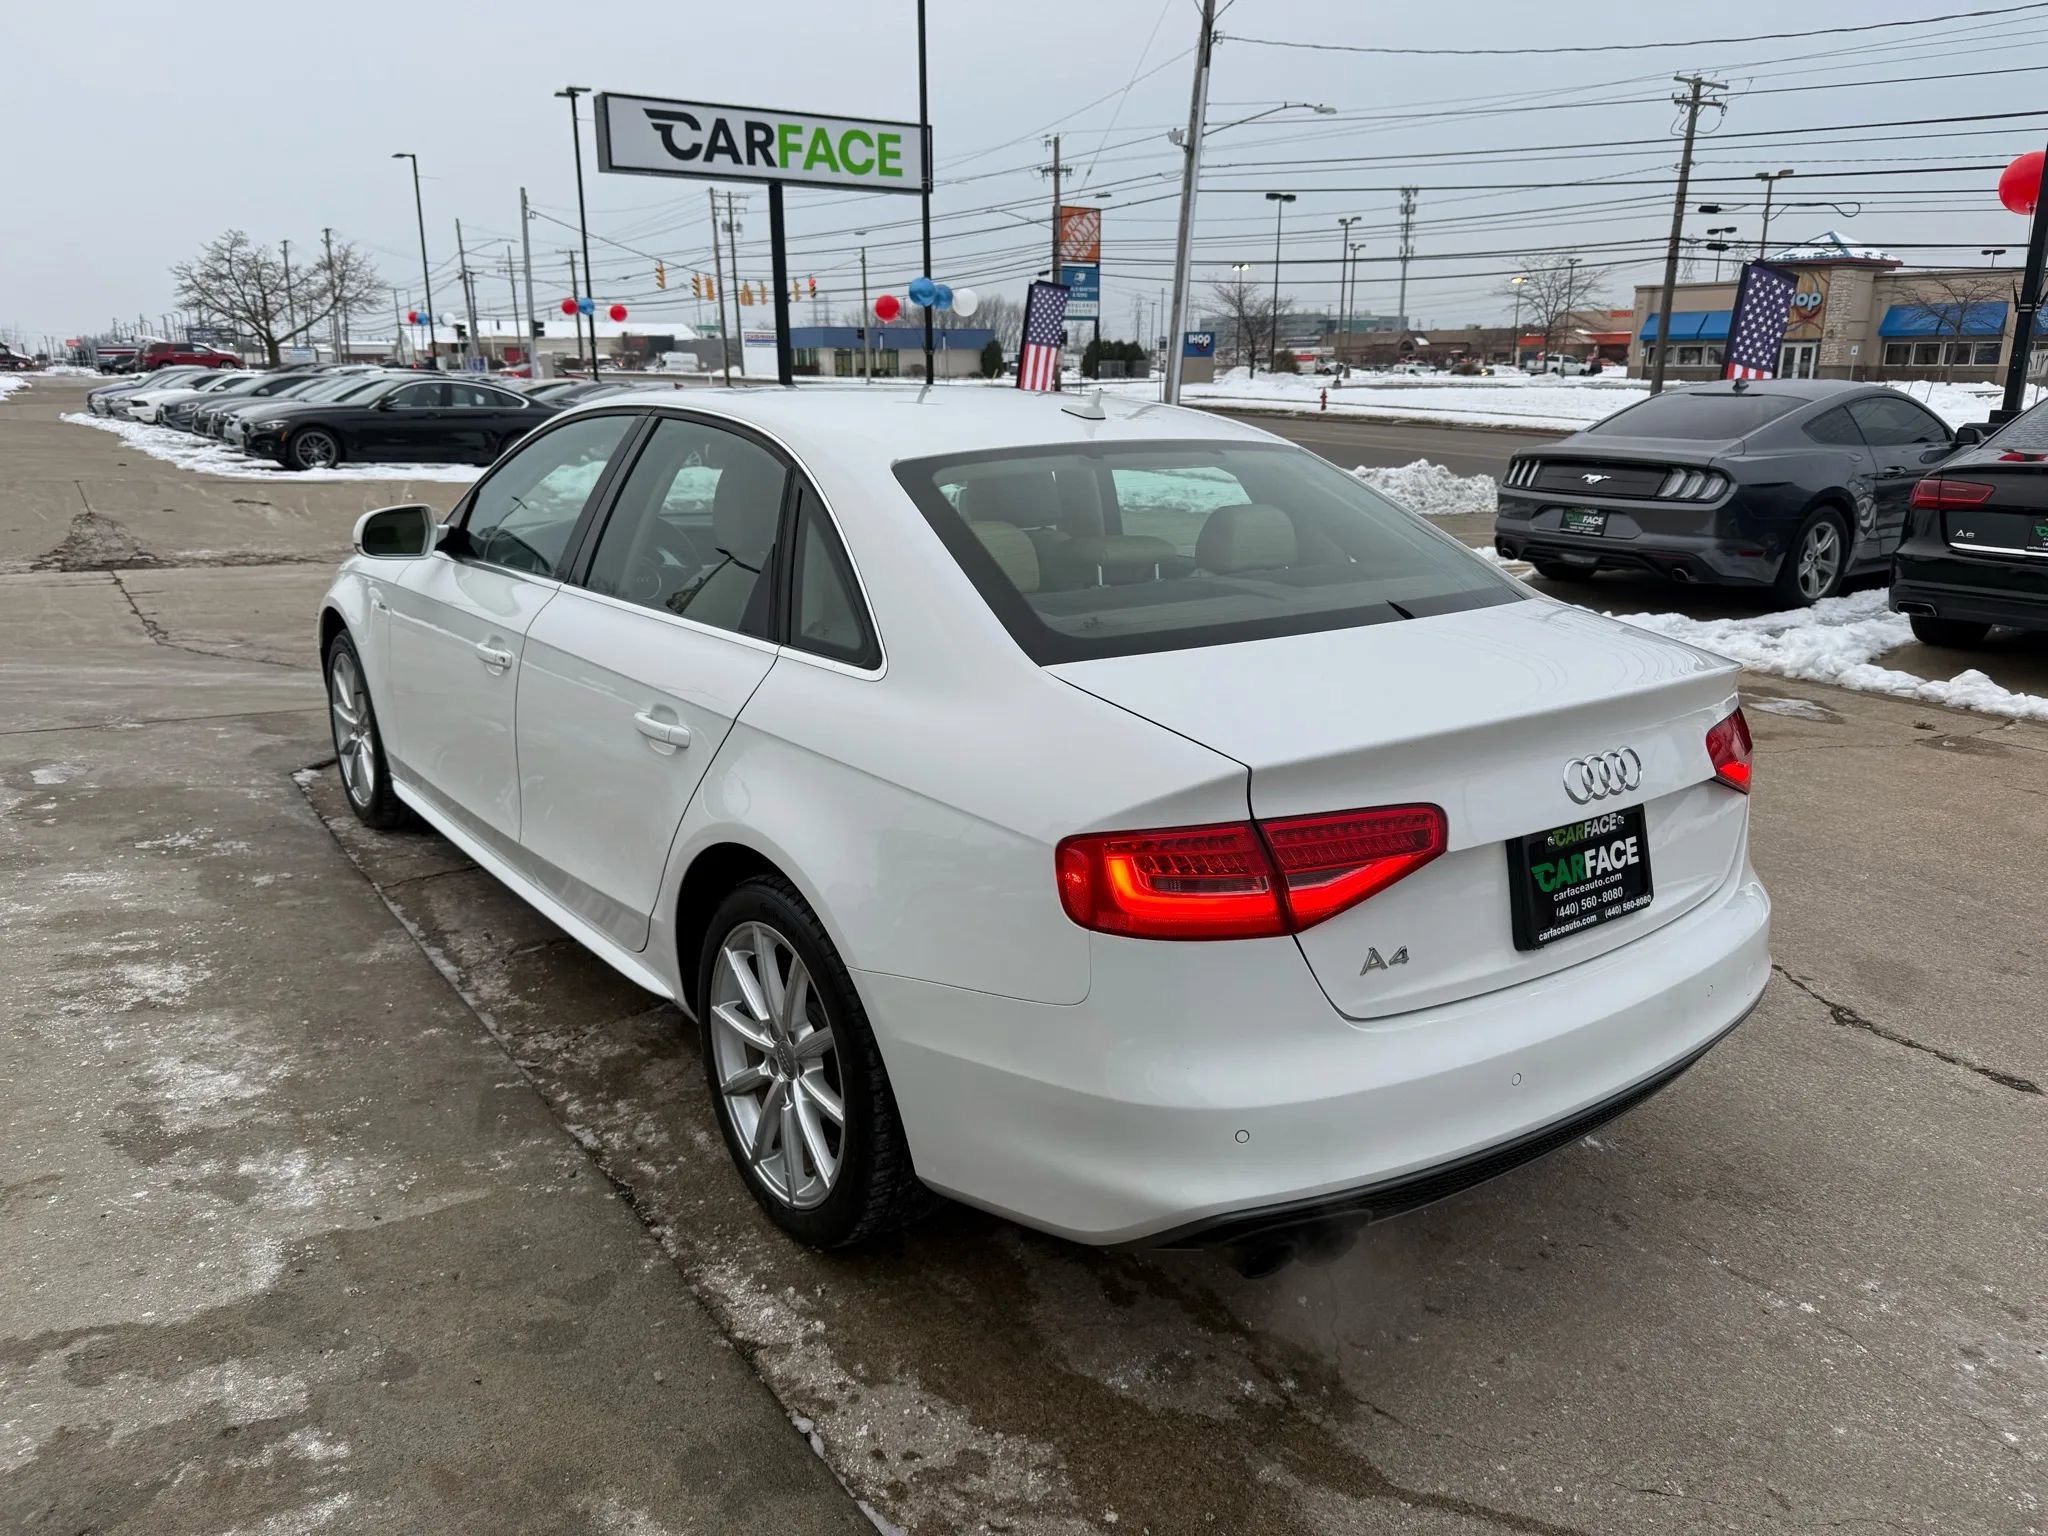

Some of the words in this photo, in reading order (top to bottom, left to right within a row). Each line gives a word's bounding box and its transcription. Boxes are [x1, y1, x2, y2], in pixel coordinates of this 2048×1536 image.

[643, 107, 903, 177] CARFACE
[1955, 529, 1975, 538] A6
[1552, 813, 1617, 847] CARFACE
[1531, 836, 1640, 893] CARFACE
[1553, 872, 1622, 902] carfaceauto.com
[1556, 901, 1579, 918] (440)
[1605, 904, 1622, 918] (440)
[1538, 914, 1597, 941] carfaceauto.com
[1360, 945, 1409, 976] A4
